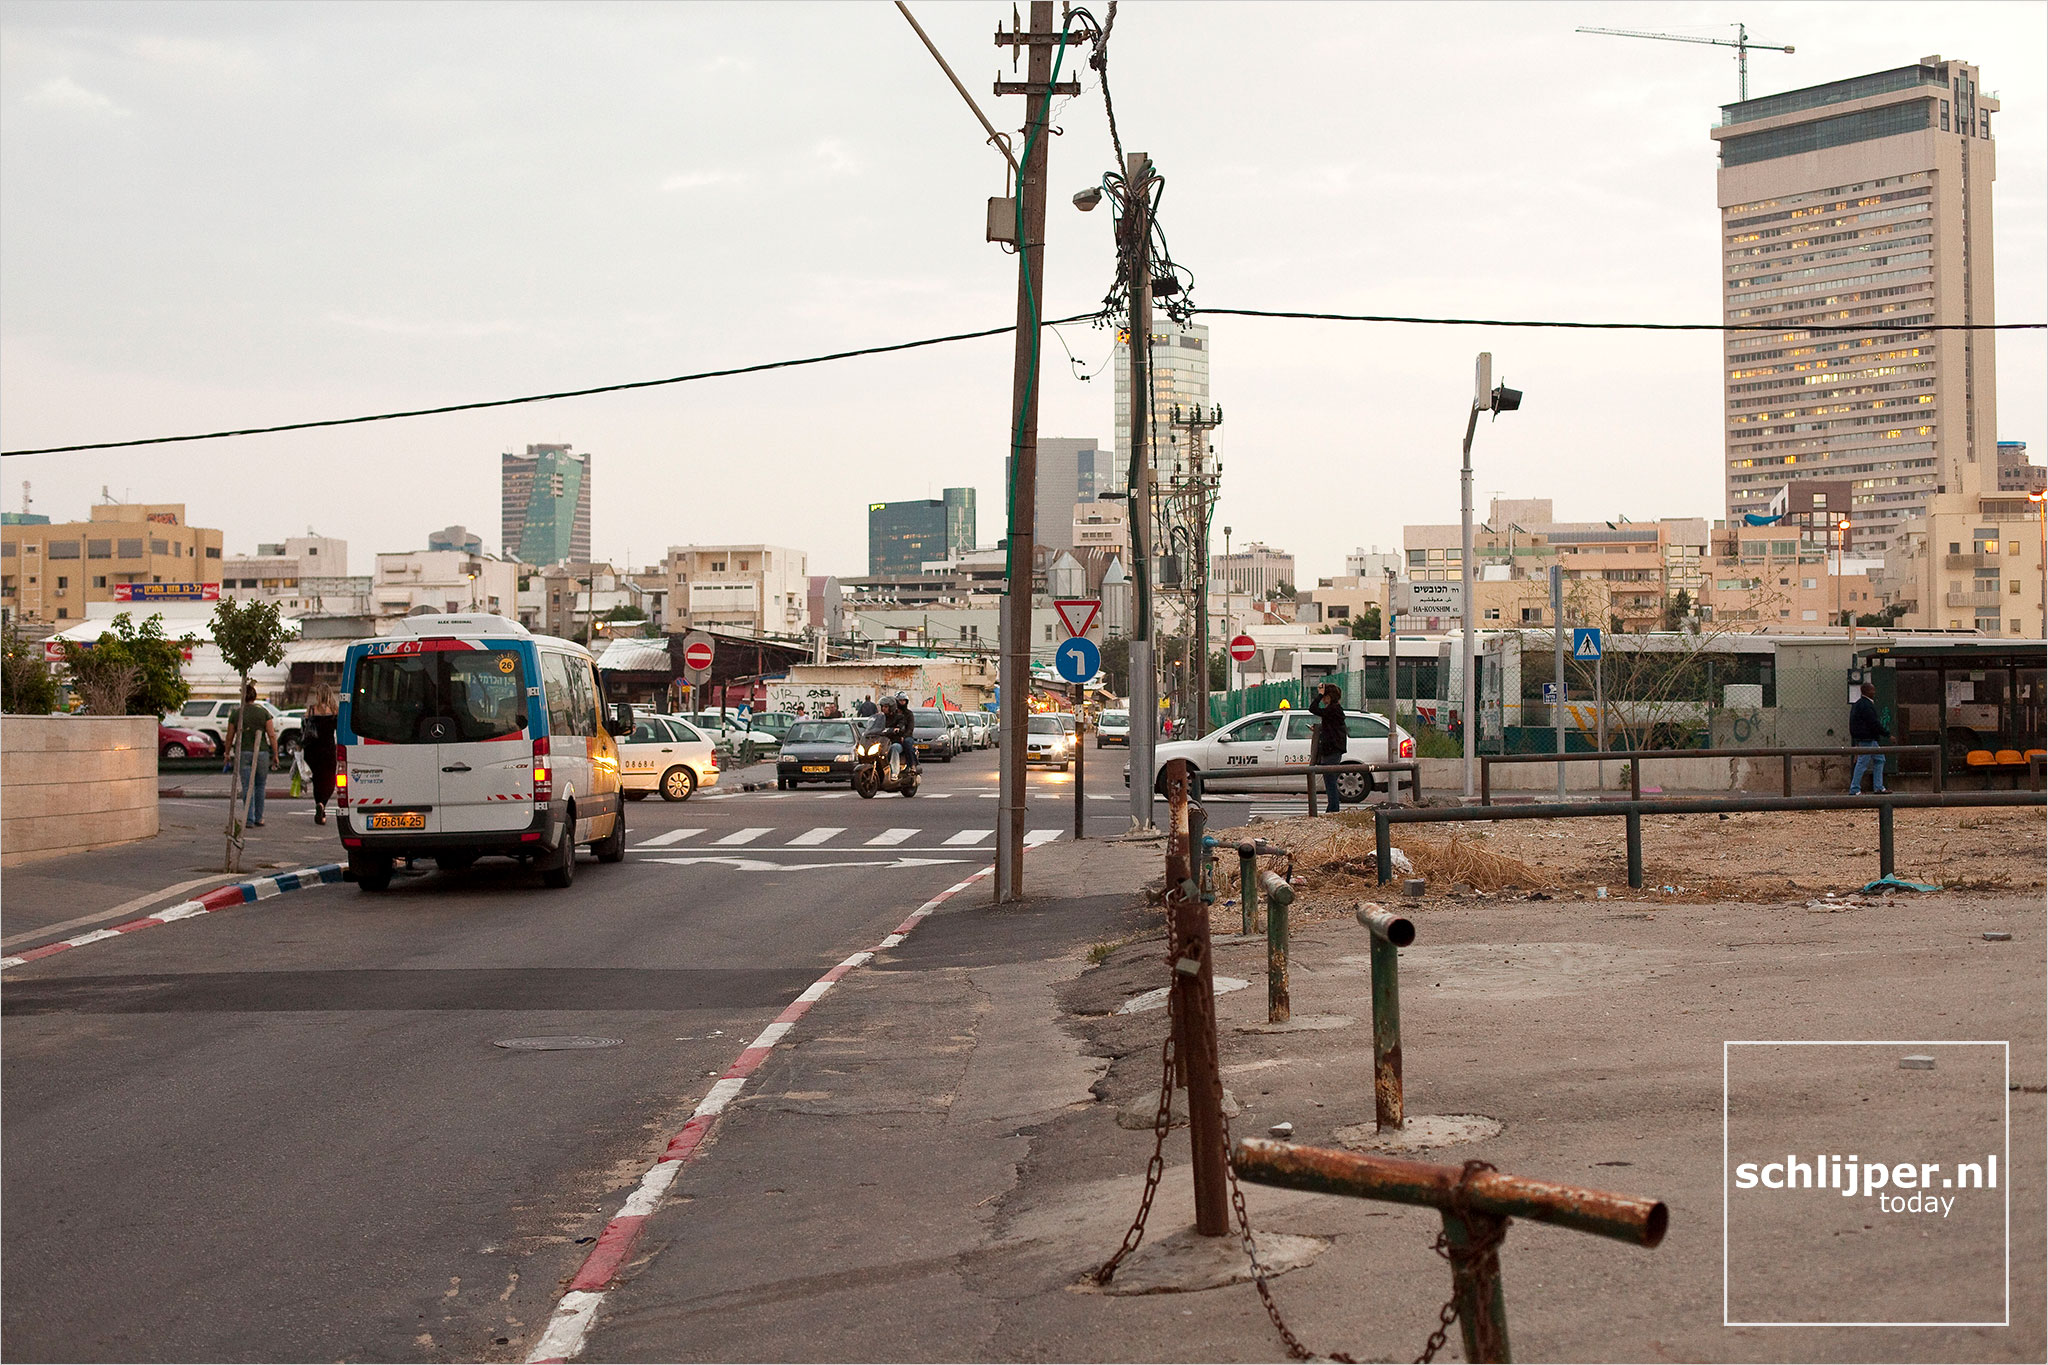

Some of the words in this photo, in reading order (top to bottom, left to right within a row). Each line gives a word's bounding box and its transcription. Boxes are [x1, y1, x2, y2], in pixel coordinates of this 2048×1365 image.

[1413, 586, 1448, 594] הכובשים
[501, 661, 512, 670] 26
[625, 760, 655, 768] 08684
